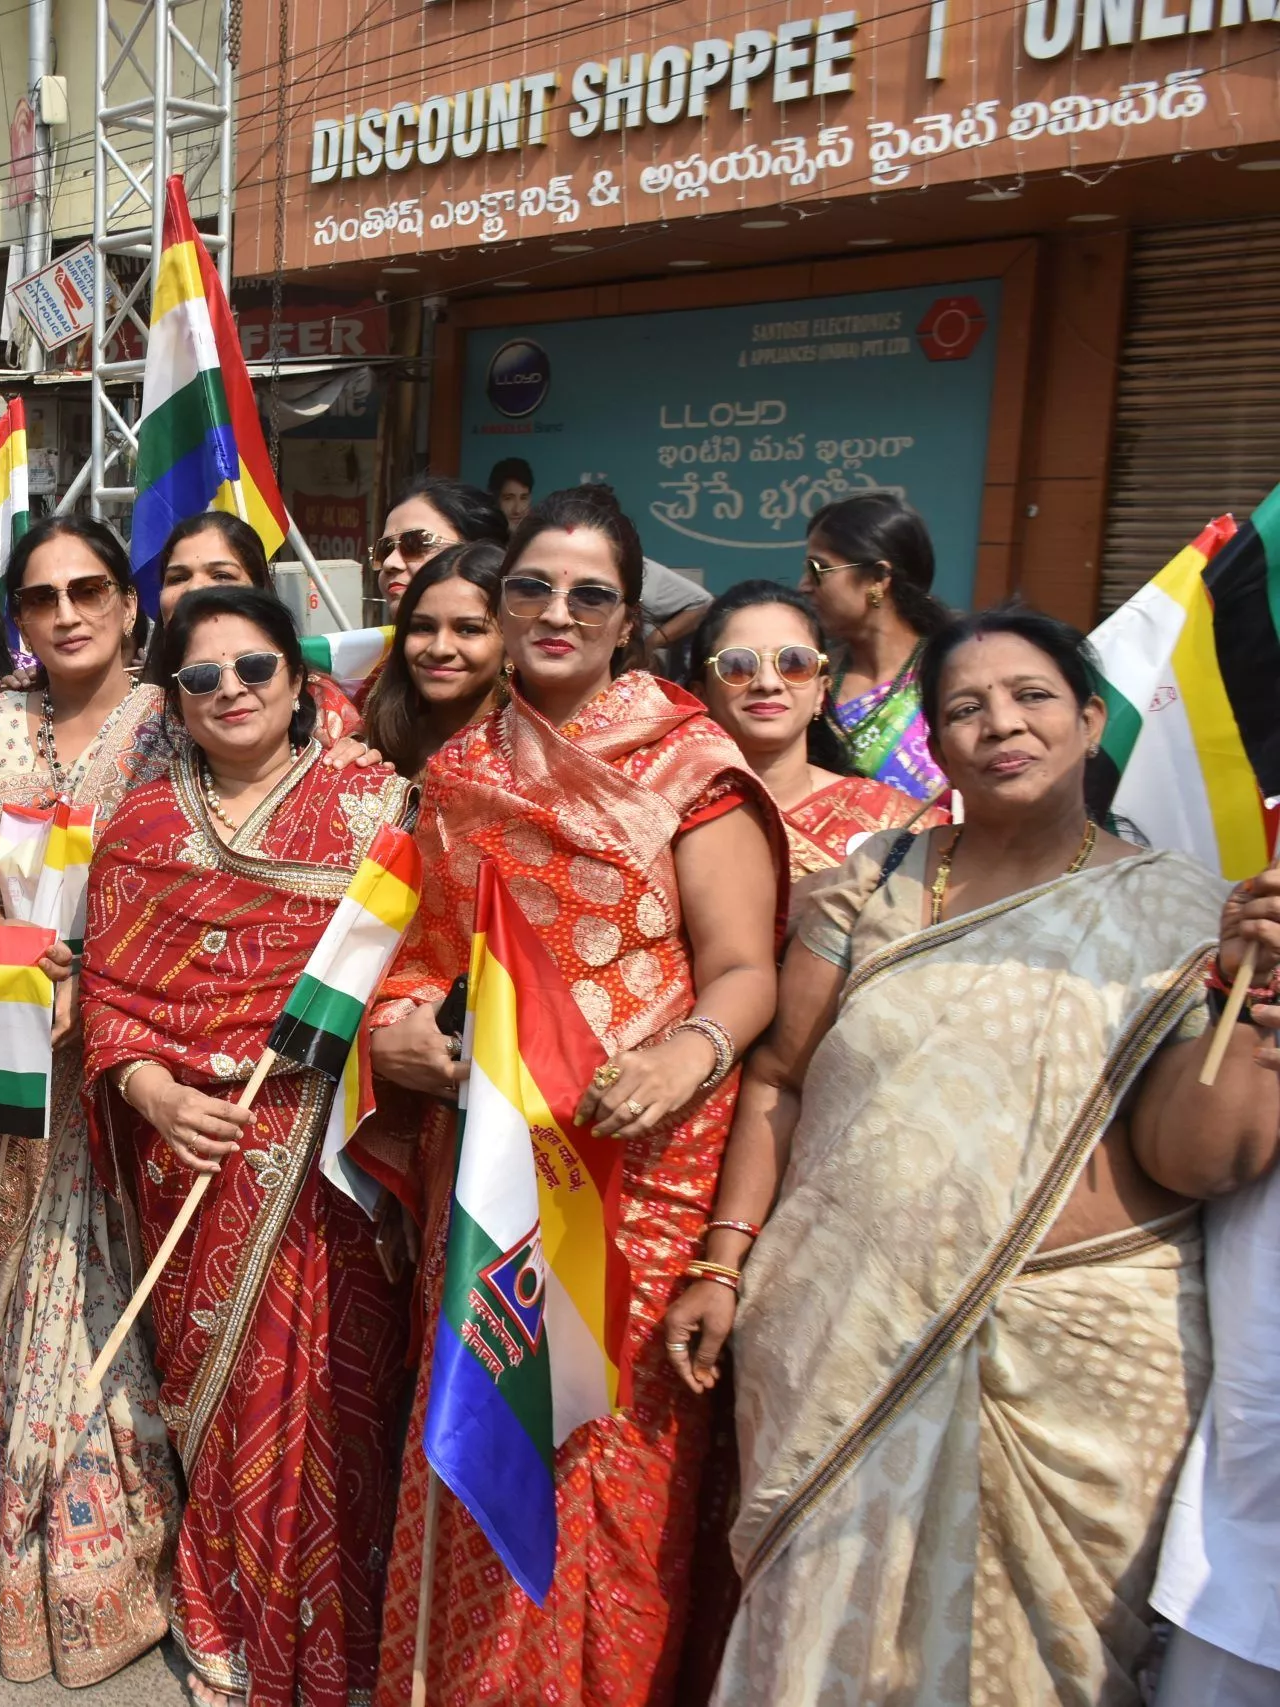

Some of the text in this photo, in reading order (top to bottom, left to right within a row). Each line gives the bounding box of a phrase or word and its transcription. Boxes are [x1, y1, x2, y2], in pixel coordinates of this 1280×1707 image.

[311, 72, 557, 184] DISCOUNT
[571, 11, 858, 138] SHOPPEE
[314, 199, 425, 246] సంతోష్
[588, 171, 620, 207] &
[25, 283, 44, 307] CITY
[39, 305, 63, 339] POLICE
[33, 279, 72, 334] HYDERABAD
[239, 318, 368, 361] FFER
[495, 371, 543, 386] LLOYD
[659, 401, 788, 429] LLOYD
